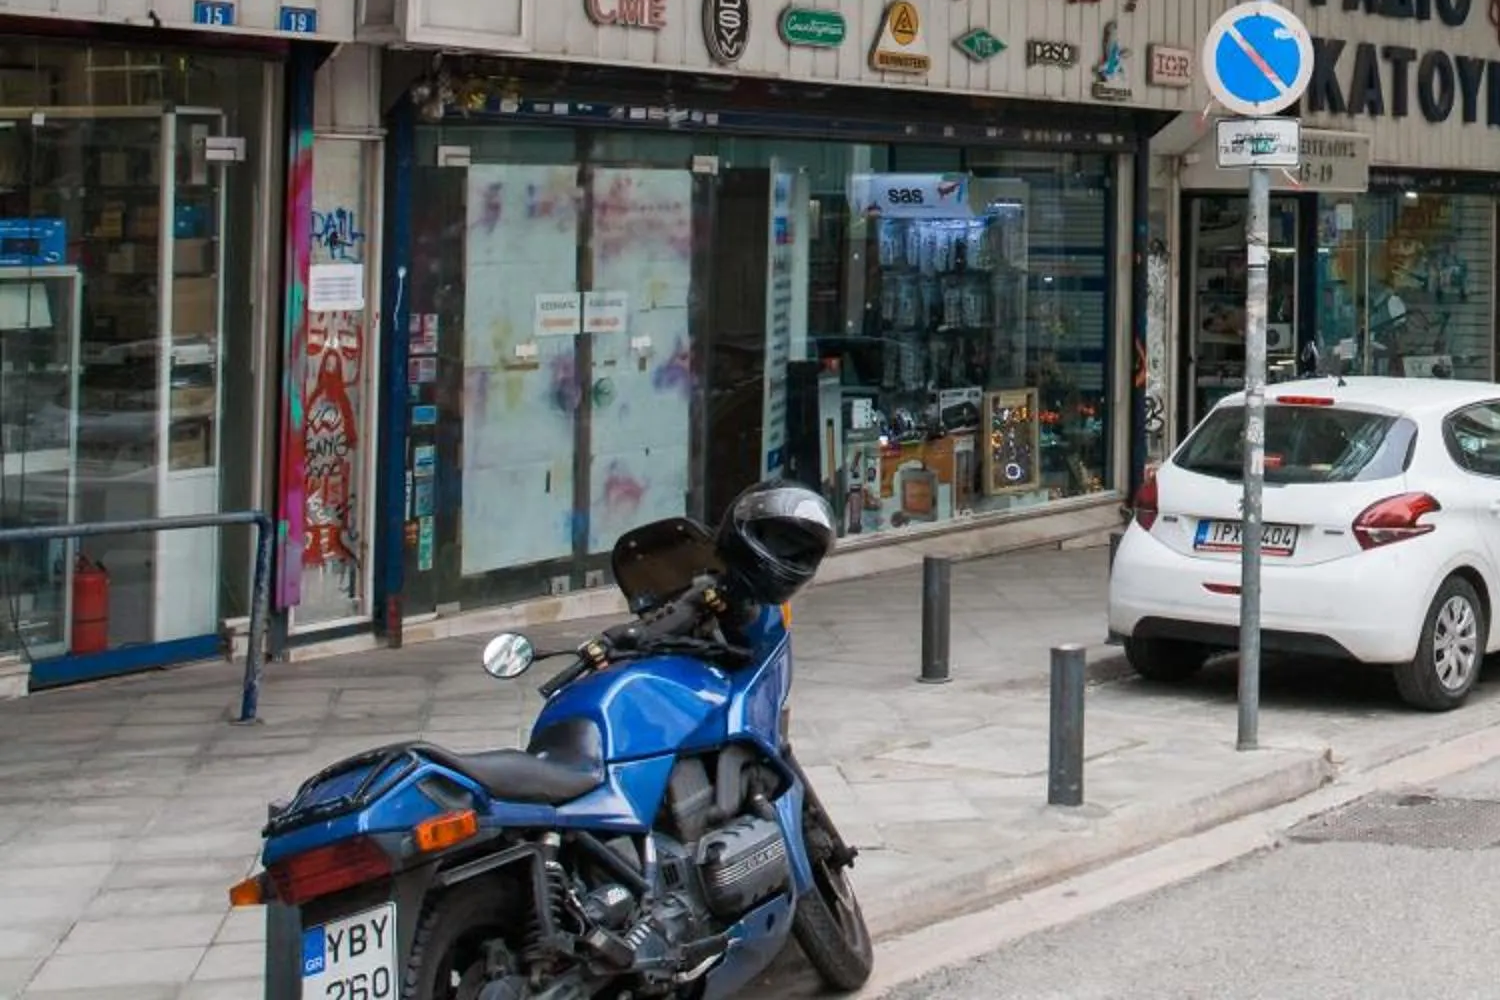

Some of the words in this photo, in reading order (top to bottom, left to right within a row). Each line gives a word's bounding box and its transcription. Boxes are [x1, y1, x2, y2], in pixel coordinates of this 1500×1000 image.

[204, 6, 224, 26] 15
[289, 13, 308, 33] 19
[887, 187, 924, 205] sas
[1250, 526, 1292, 546] 404
[327, 914, 389, 964] YBY
[304, 956, 324, 972] GR
[325, 966, 391, 1000] 260
